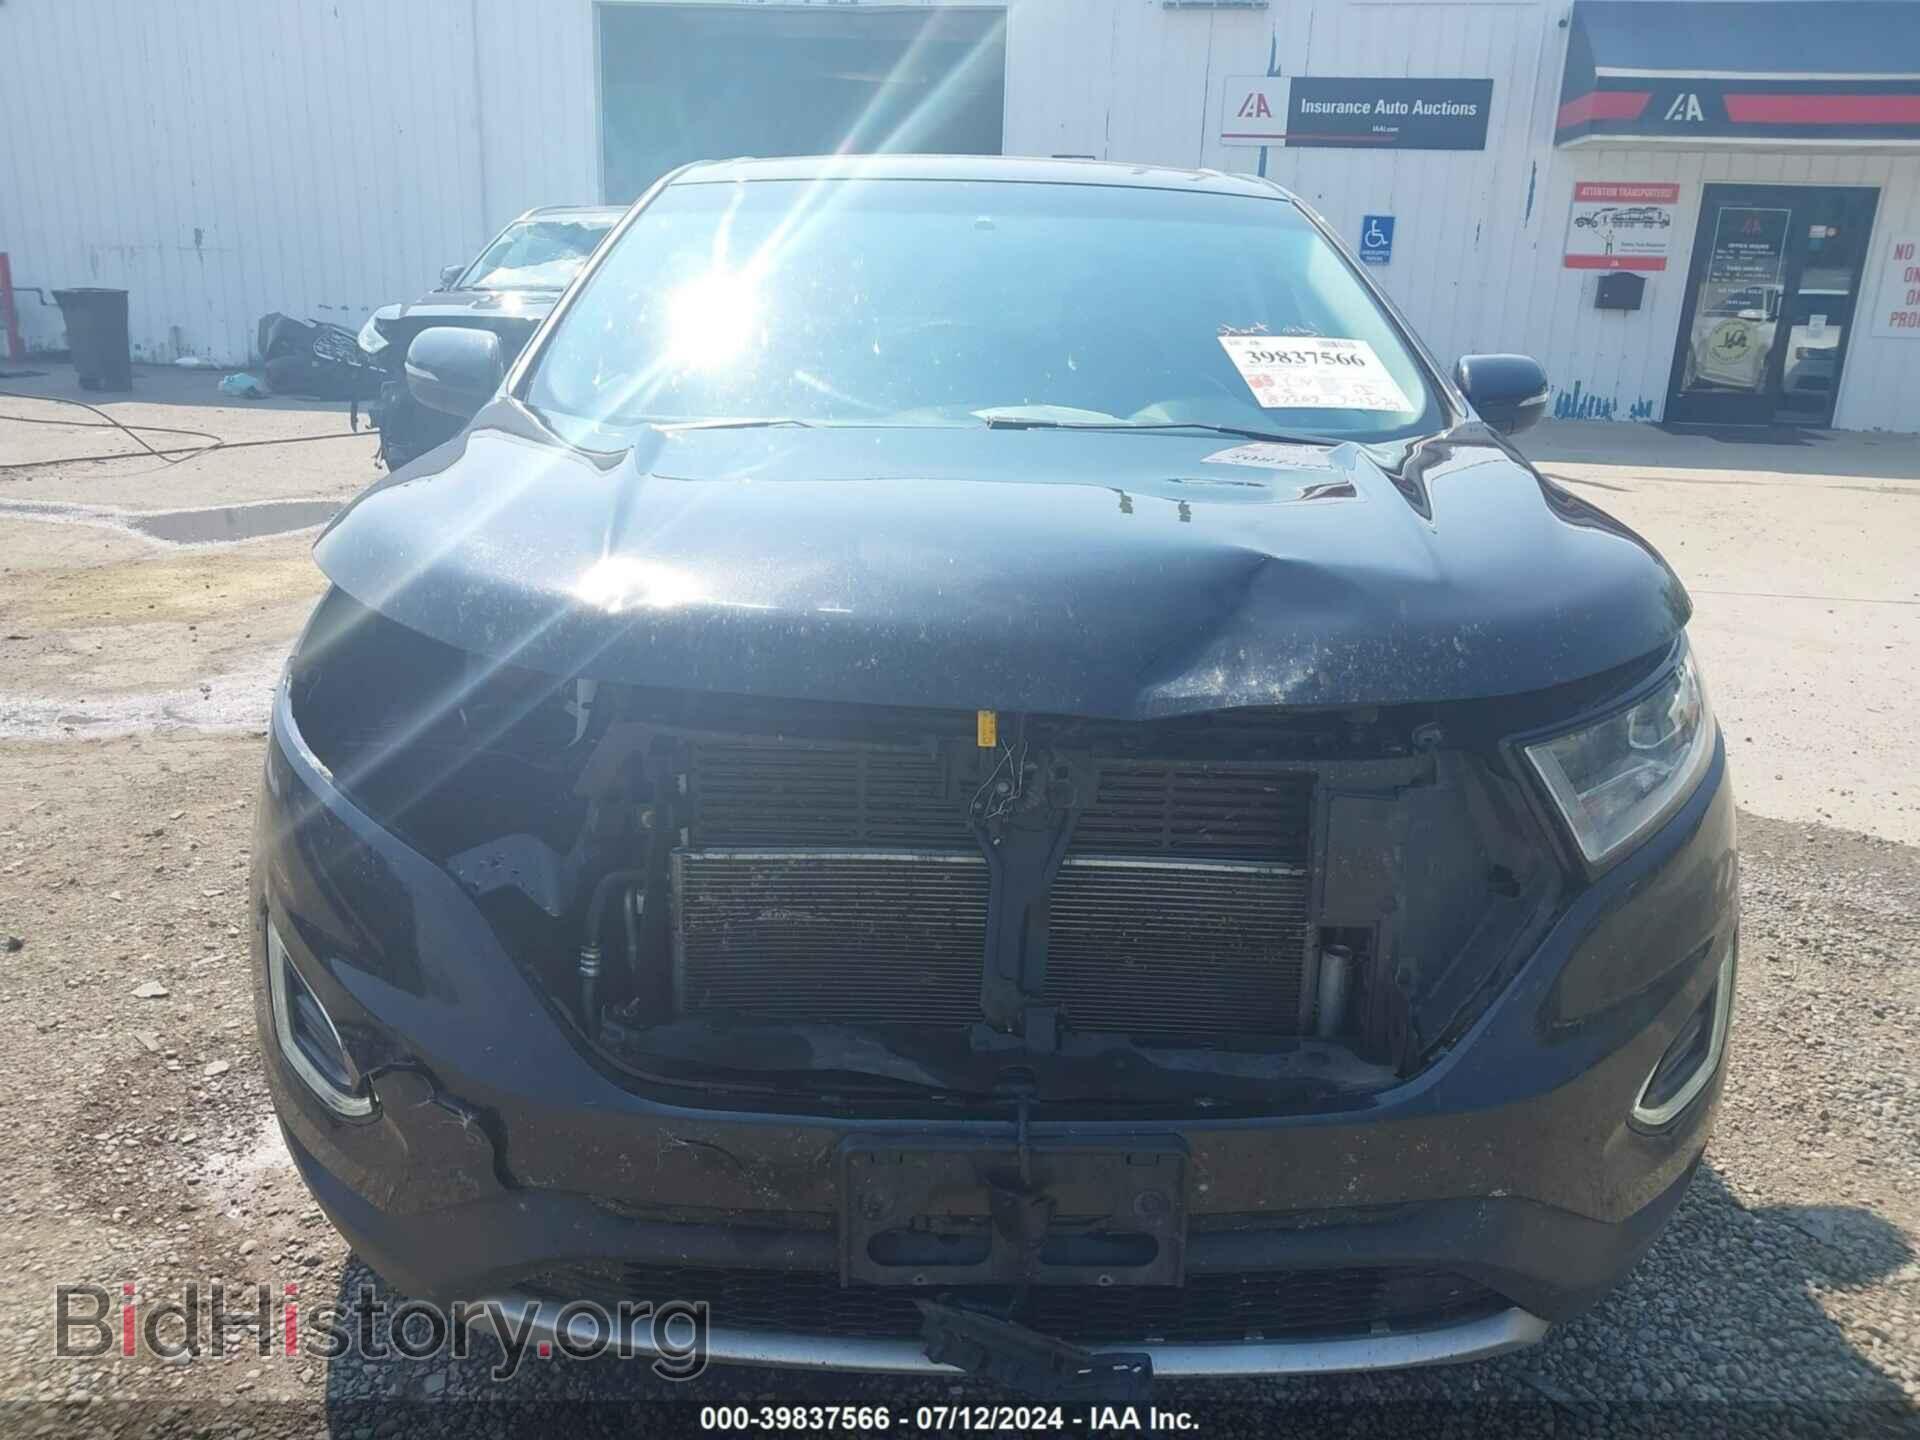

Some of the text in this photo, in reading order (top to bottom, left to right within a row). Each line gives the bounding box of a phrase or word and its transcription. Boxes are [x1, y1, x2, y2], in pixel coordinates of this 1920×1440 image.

[1301, 98, 1477, 116] Insurance Auto Auctions
[1893, 243, 1914, 261] NO
[1246, 350, 1366, 367] 39837566
